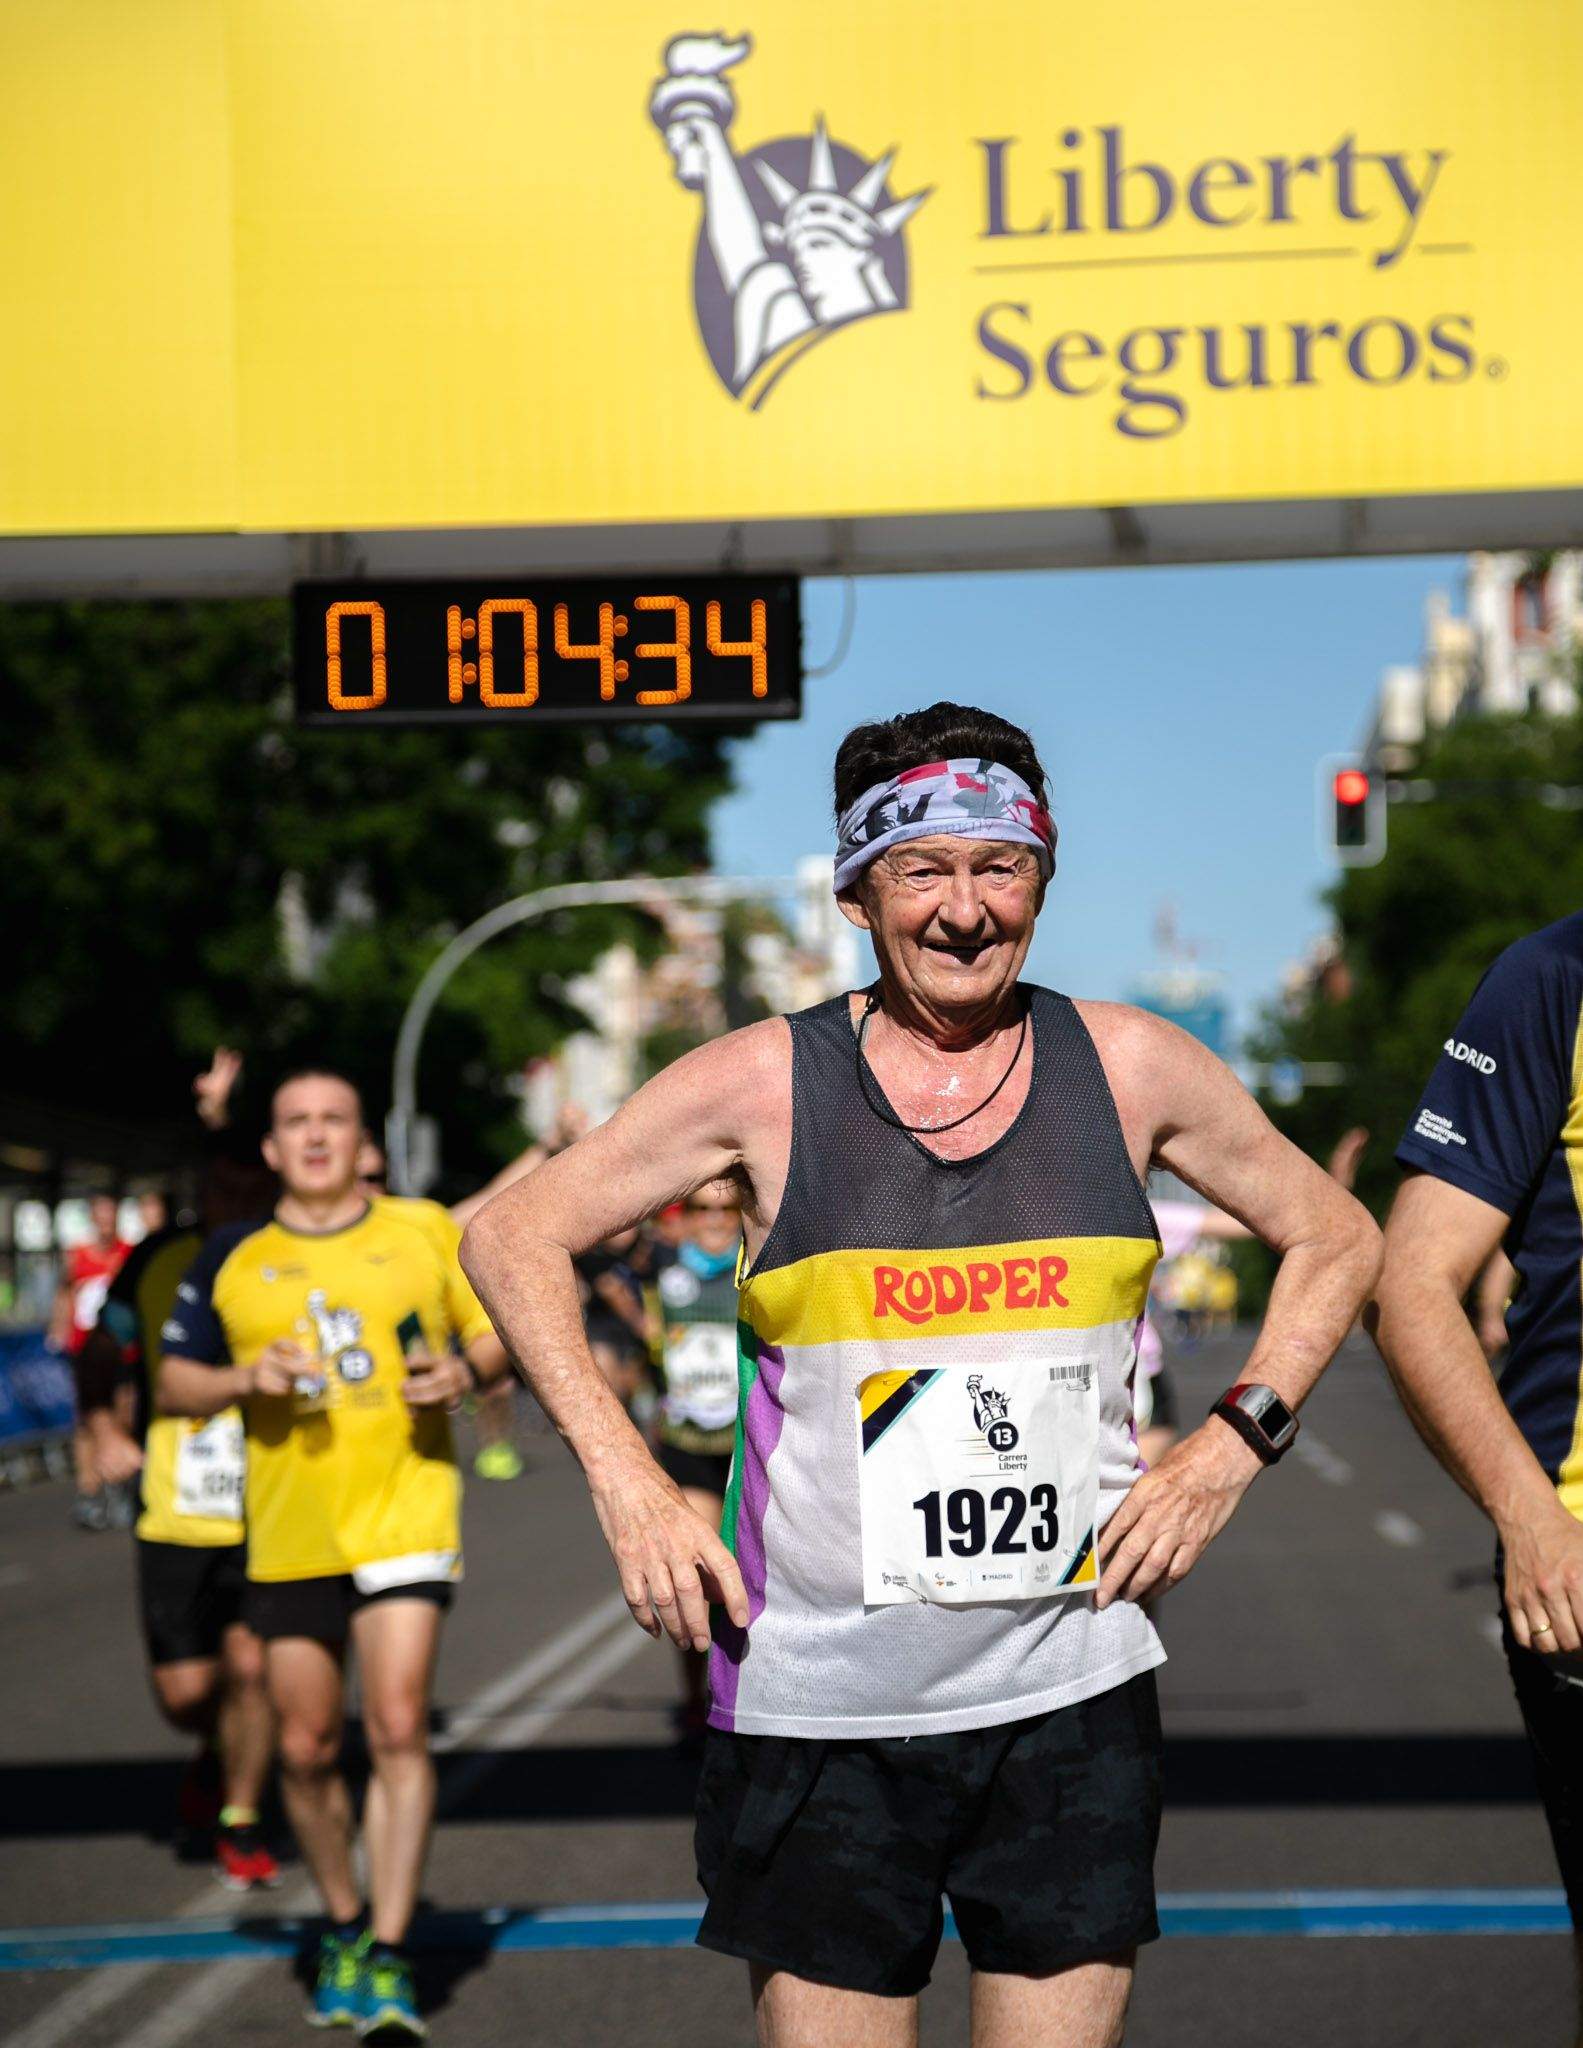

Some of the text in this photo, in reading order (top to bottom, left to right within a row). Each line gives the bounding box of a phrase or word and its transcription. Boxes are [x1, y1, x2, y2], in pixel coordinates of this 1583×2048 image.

[974, 124, 1450, 269] Liberty
[325, 600, 388, 711] 0
[873, 1256, 1069, 1324] RODPER
[993, 1427, 1013, 1446] 13
[998, 1453, 1028, 1462] Carrera
[998, 1461, 1029, 1472] Liberty
[912, 1483, 1059, 1559] 1923
